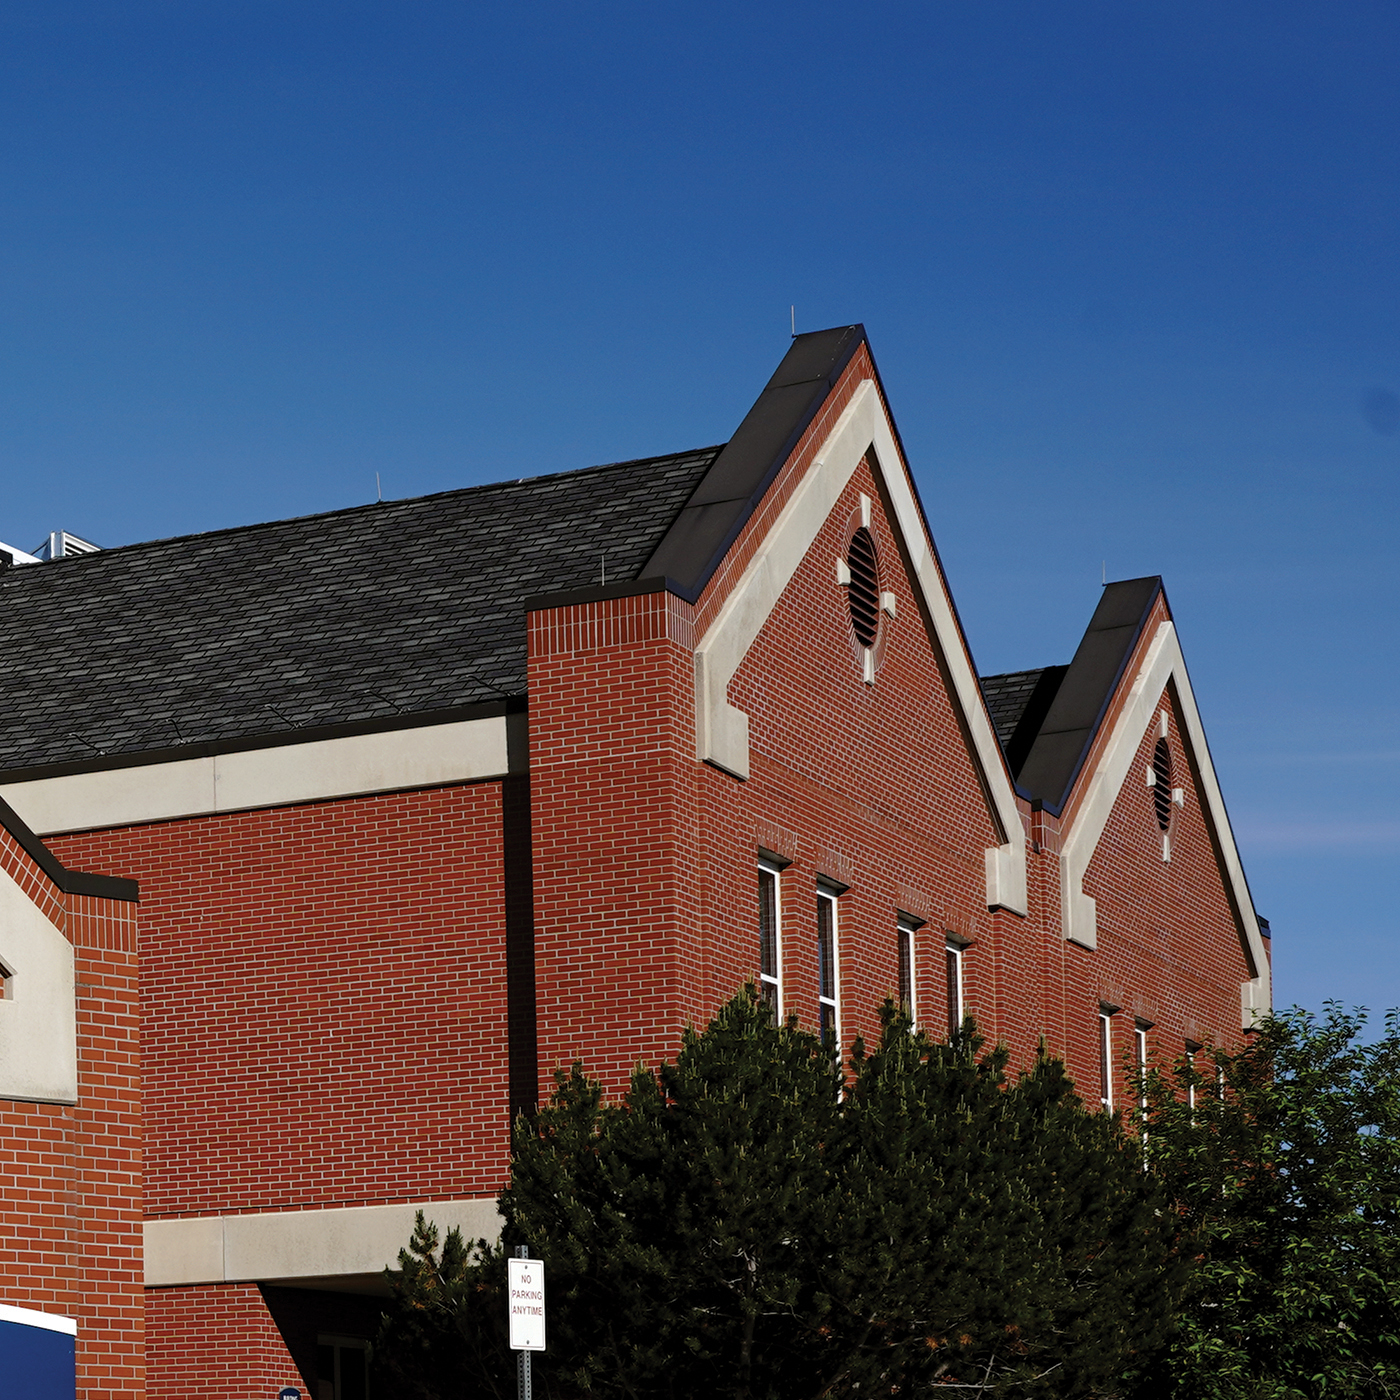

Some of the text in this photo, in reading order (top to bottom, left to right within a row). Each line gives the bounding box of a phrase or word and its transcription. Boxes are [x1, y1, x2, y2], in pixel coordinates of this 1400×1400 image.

[521, 1275, 532, 1284] NO
[512, 1290, 543, 1300] PARKING
[512, 1305, 543, 1316] ANYTIME
